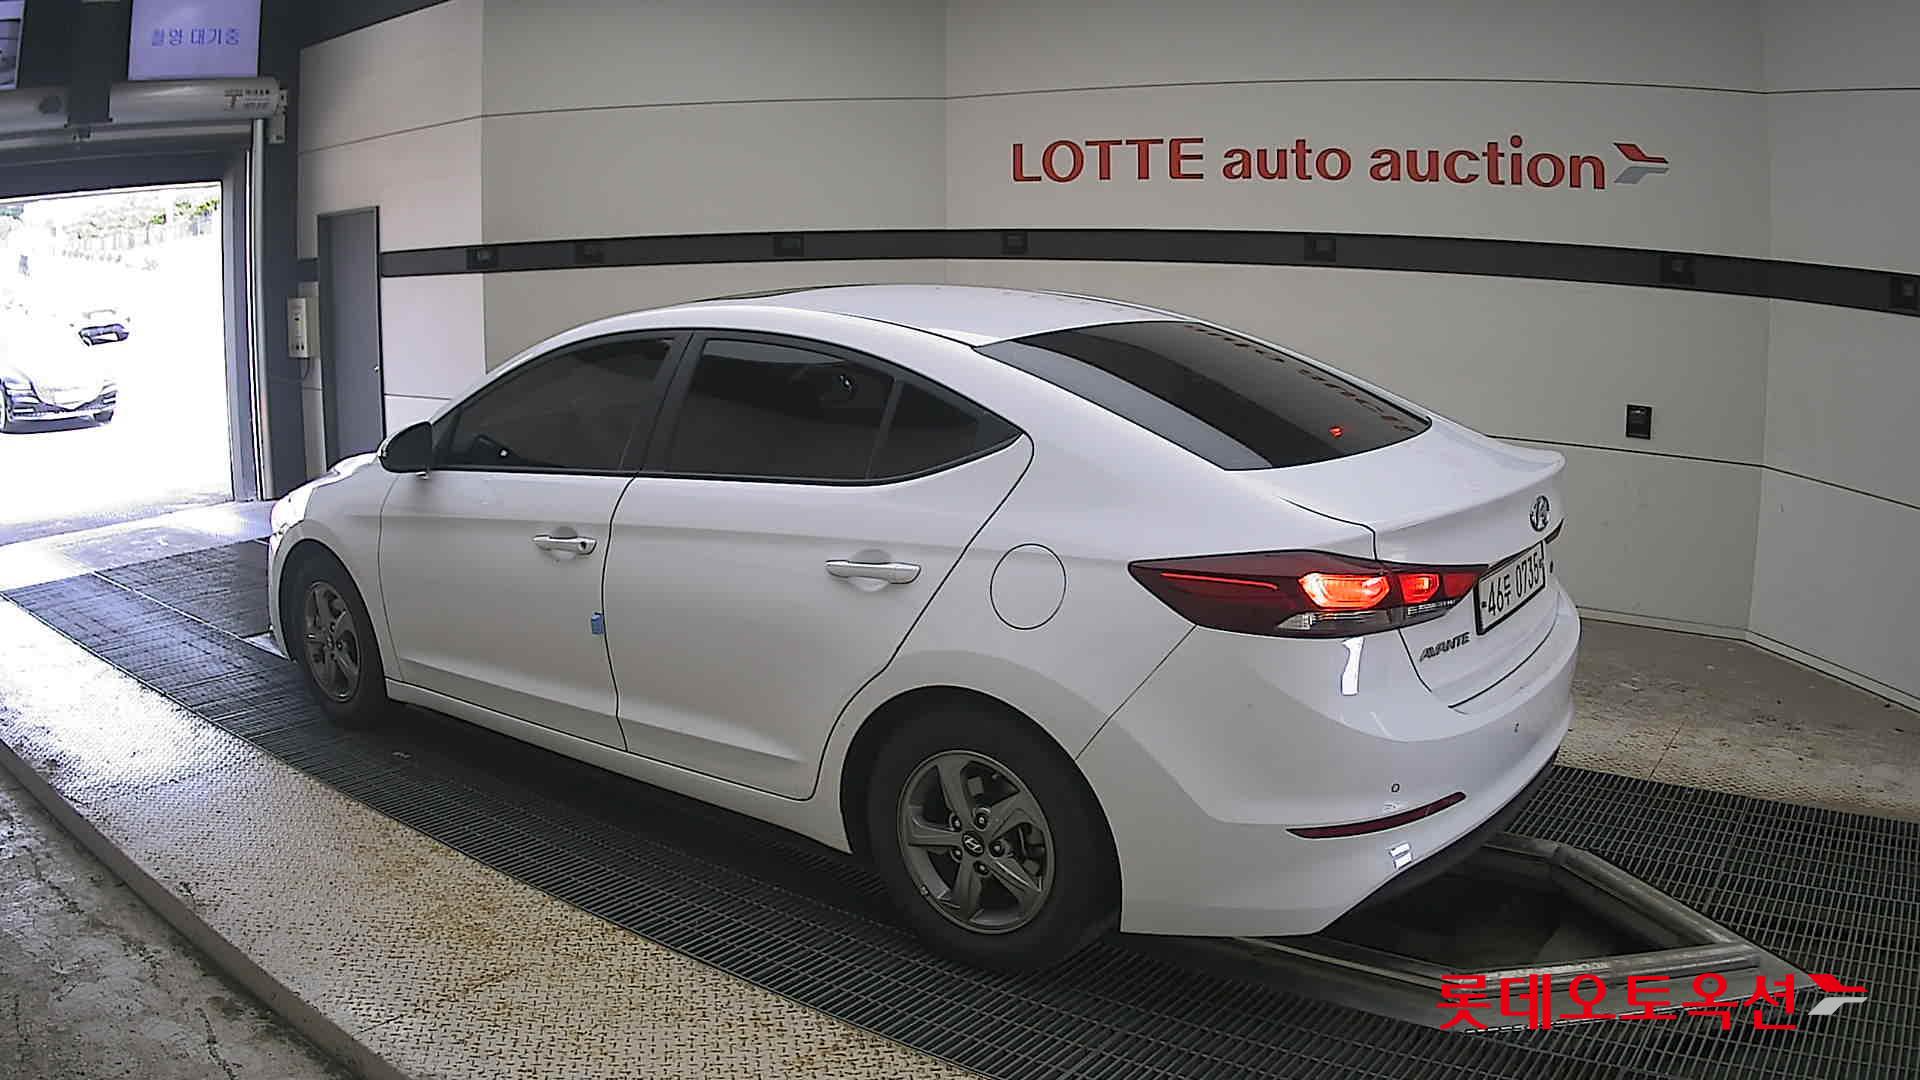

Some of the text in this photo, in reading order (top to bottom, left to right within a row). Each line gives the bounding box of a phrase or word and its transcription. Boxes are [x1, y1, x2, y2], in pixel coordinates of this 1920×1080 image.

[1012, 135, 1606, 190] LOTTE auto auction
[1515, 552, 1540, 598] 0735
[1419, 631, 1471, 662] AVANTE
